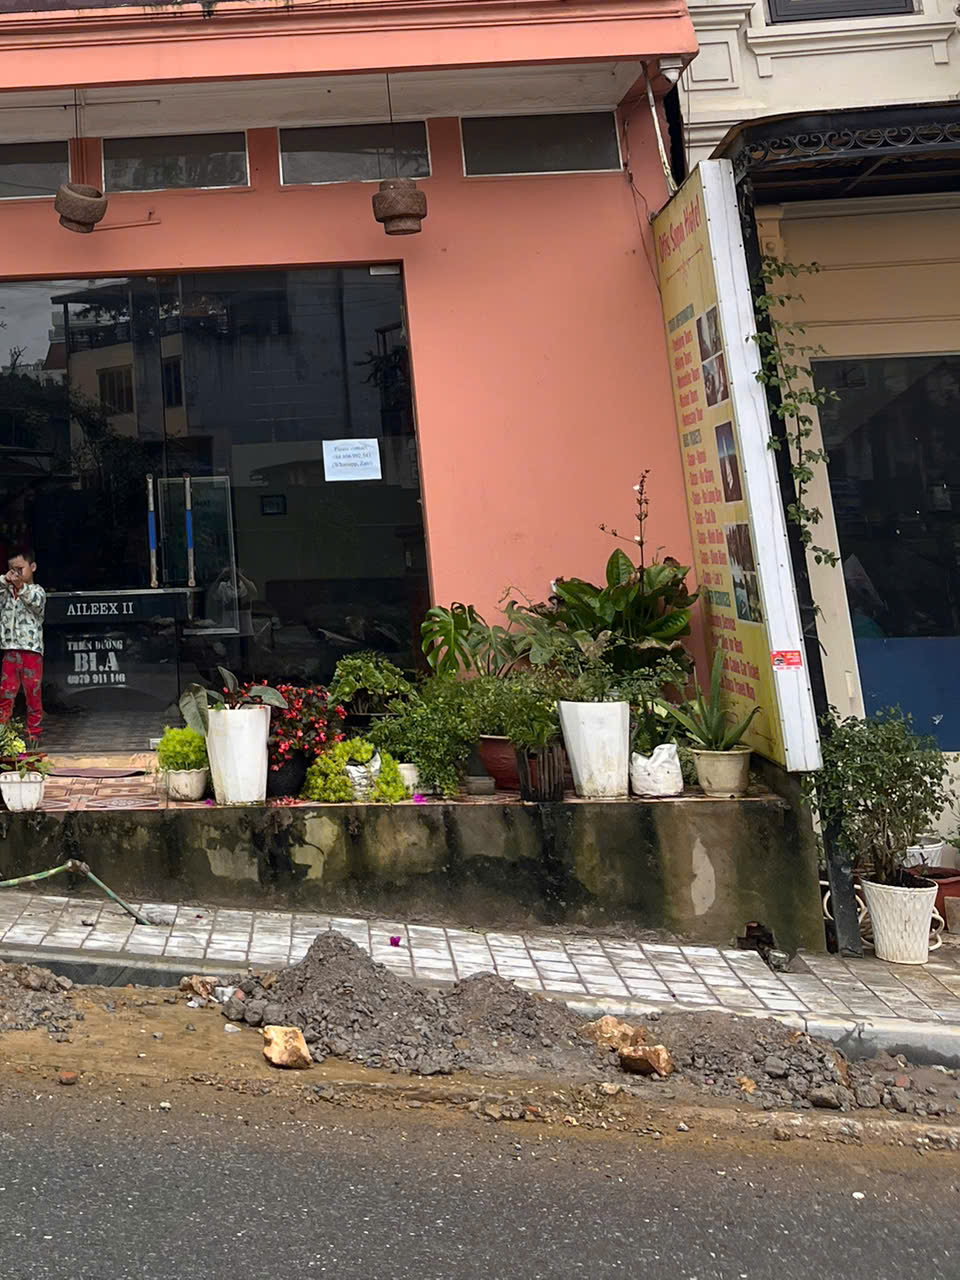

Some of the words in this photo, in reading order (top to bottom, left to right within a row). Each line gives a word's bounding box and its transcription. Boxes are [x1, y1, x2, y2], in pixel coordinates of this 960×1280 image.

[683, 194, 701, 237] Hotel
[66, 603, 119, 616] AILEEX
[122, 601, 134, 615] II
[74, 651, 121, 672] BI.A
